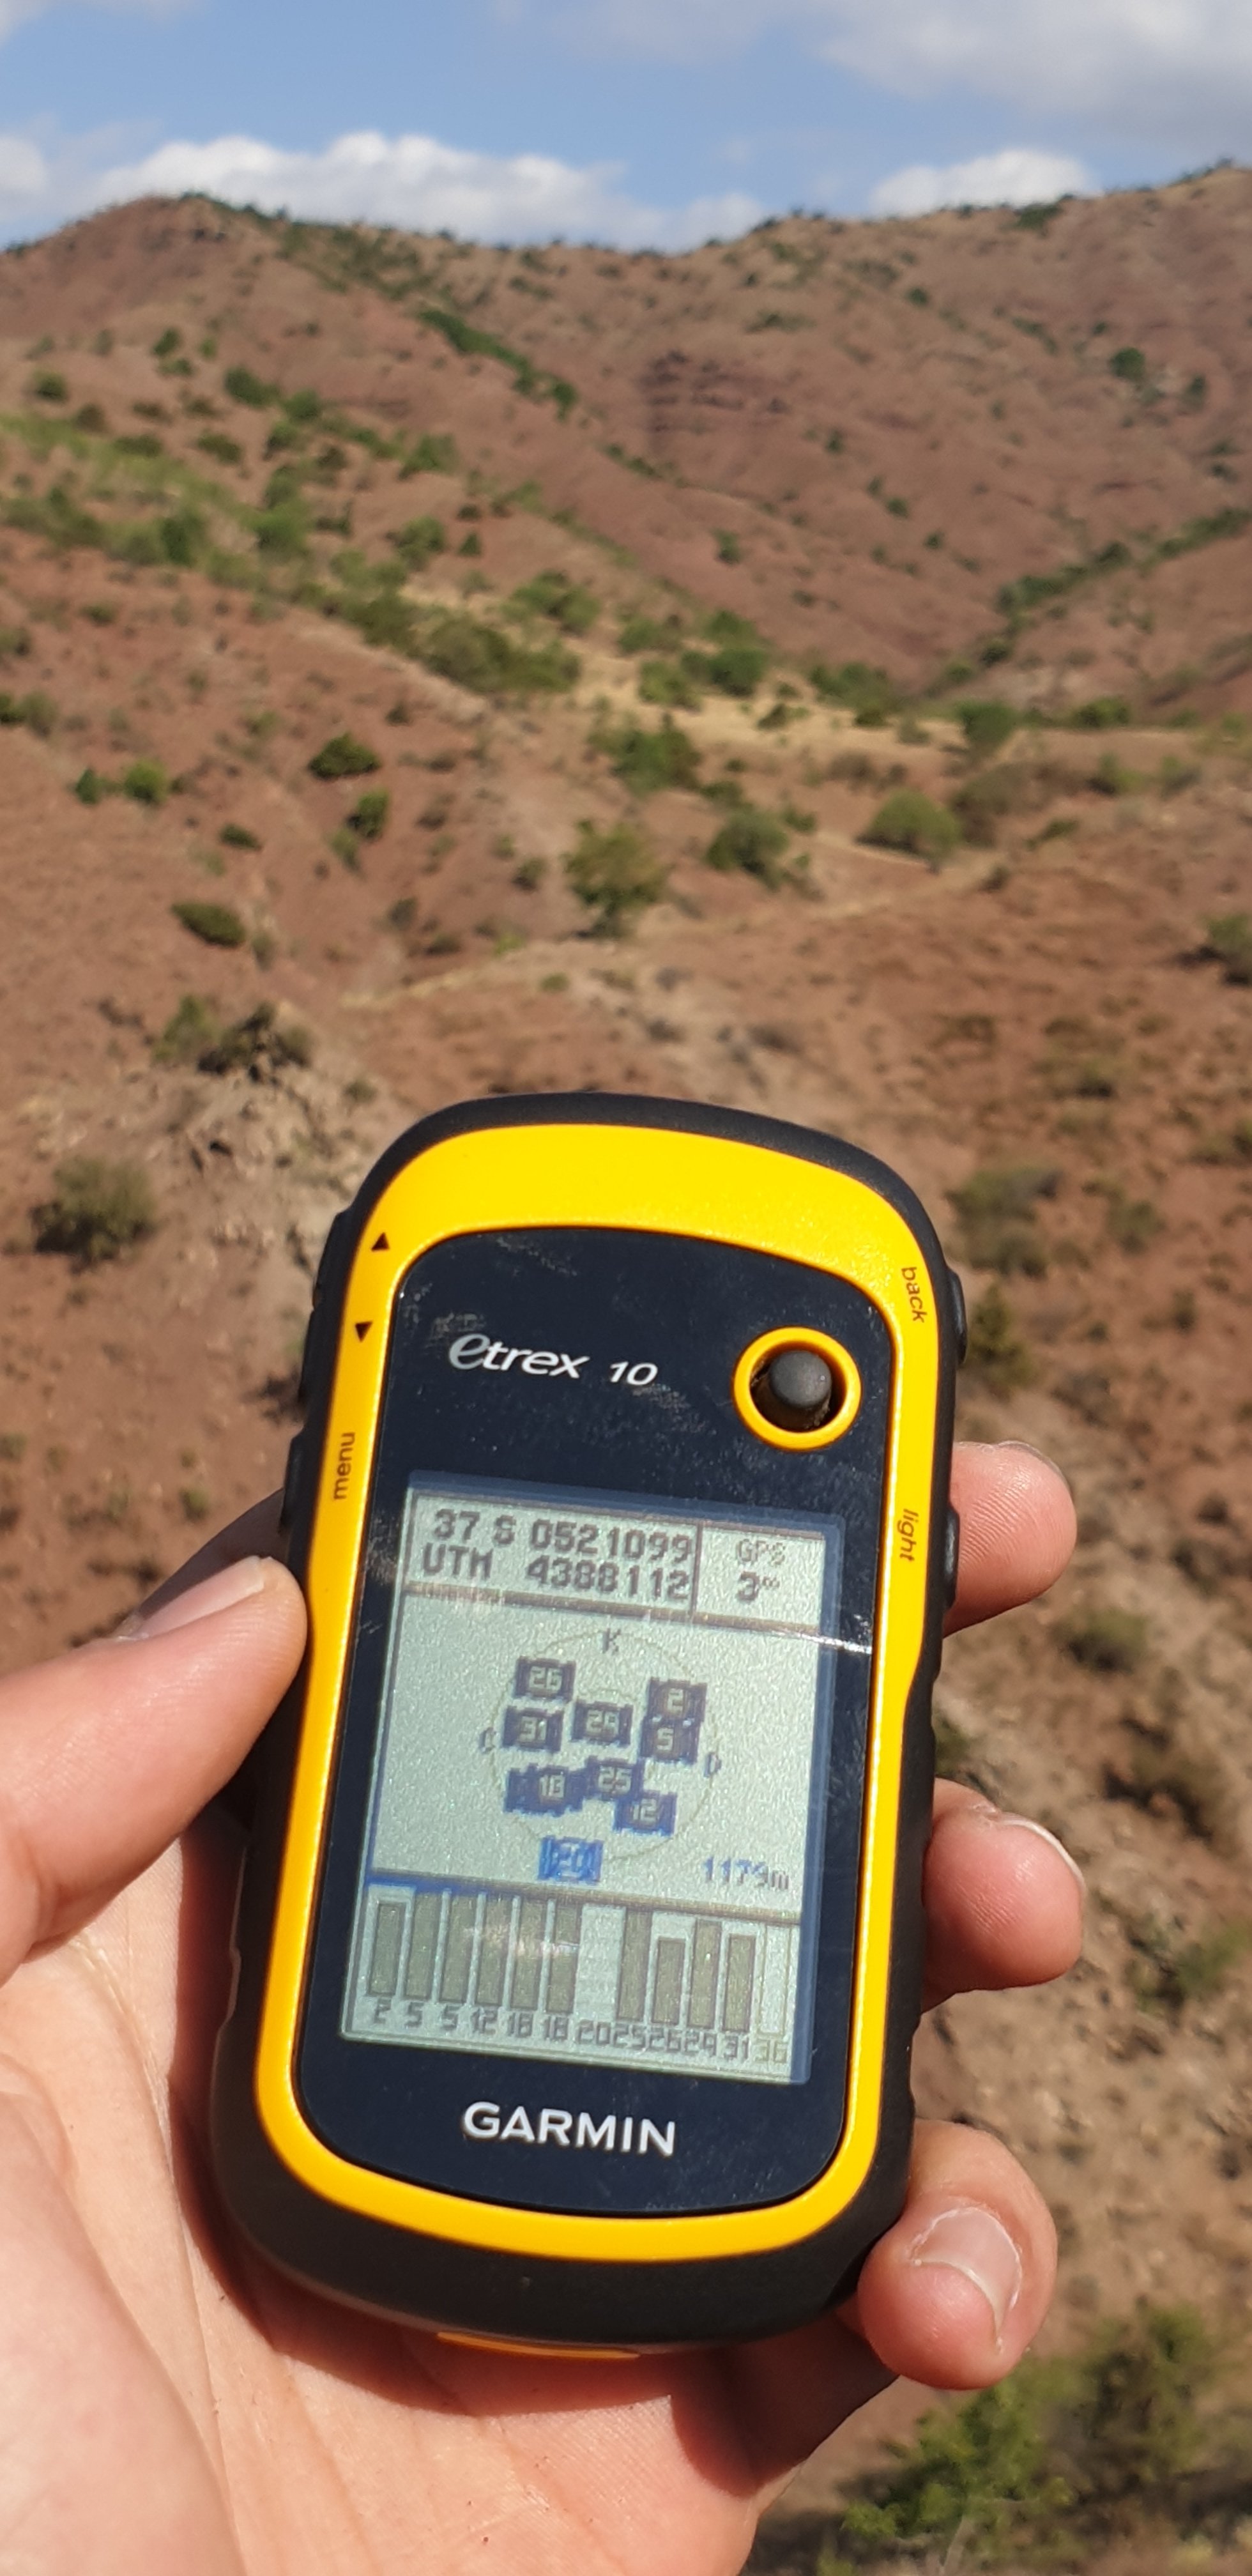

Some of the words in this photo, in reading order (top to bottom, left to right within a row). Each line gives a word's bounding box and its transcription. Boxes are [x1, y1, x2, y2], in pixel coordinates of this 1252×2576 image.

[901, 1267, 928, 1323] back
[609, 1361, 658, 1386] 10
[333, 1432, 355, 1499] menu
[434, 1508, 480, 1541] 37
[531, 1518, 692, 1563] 0521099
[897, 1508, 919, 1562] light
[737, 1538, 786, 1566] GPS
[423, 1542, 494, 1581] UTM
[526, 1554, 691, 1598] 4388112
[602, 1629, 621, 1654] K
[666, 1688, 685, 1720] 2
[655, 1727, 675, 1752] 5
[597, 1765, 632, 1796] 25
[630, 1797, 659, 1823] 12
[462, 2101, 676, 2158] GARMIN
